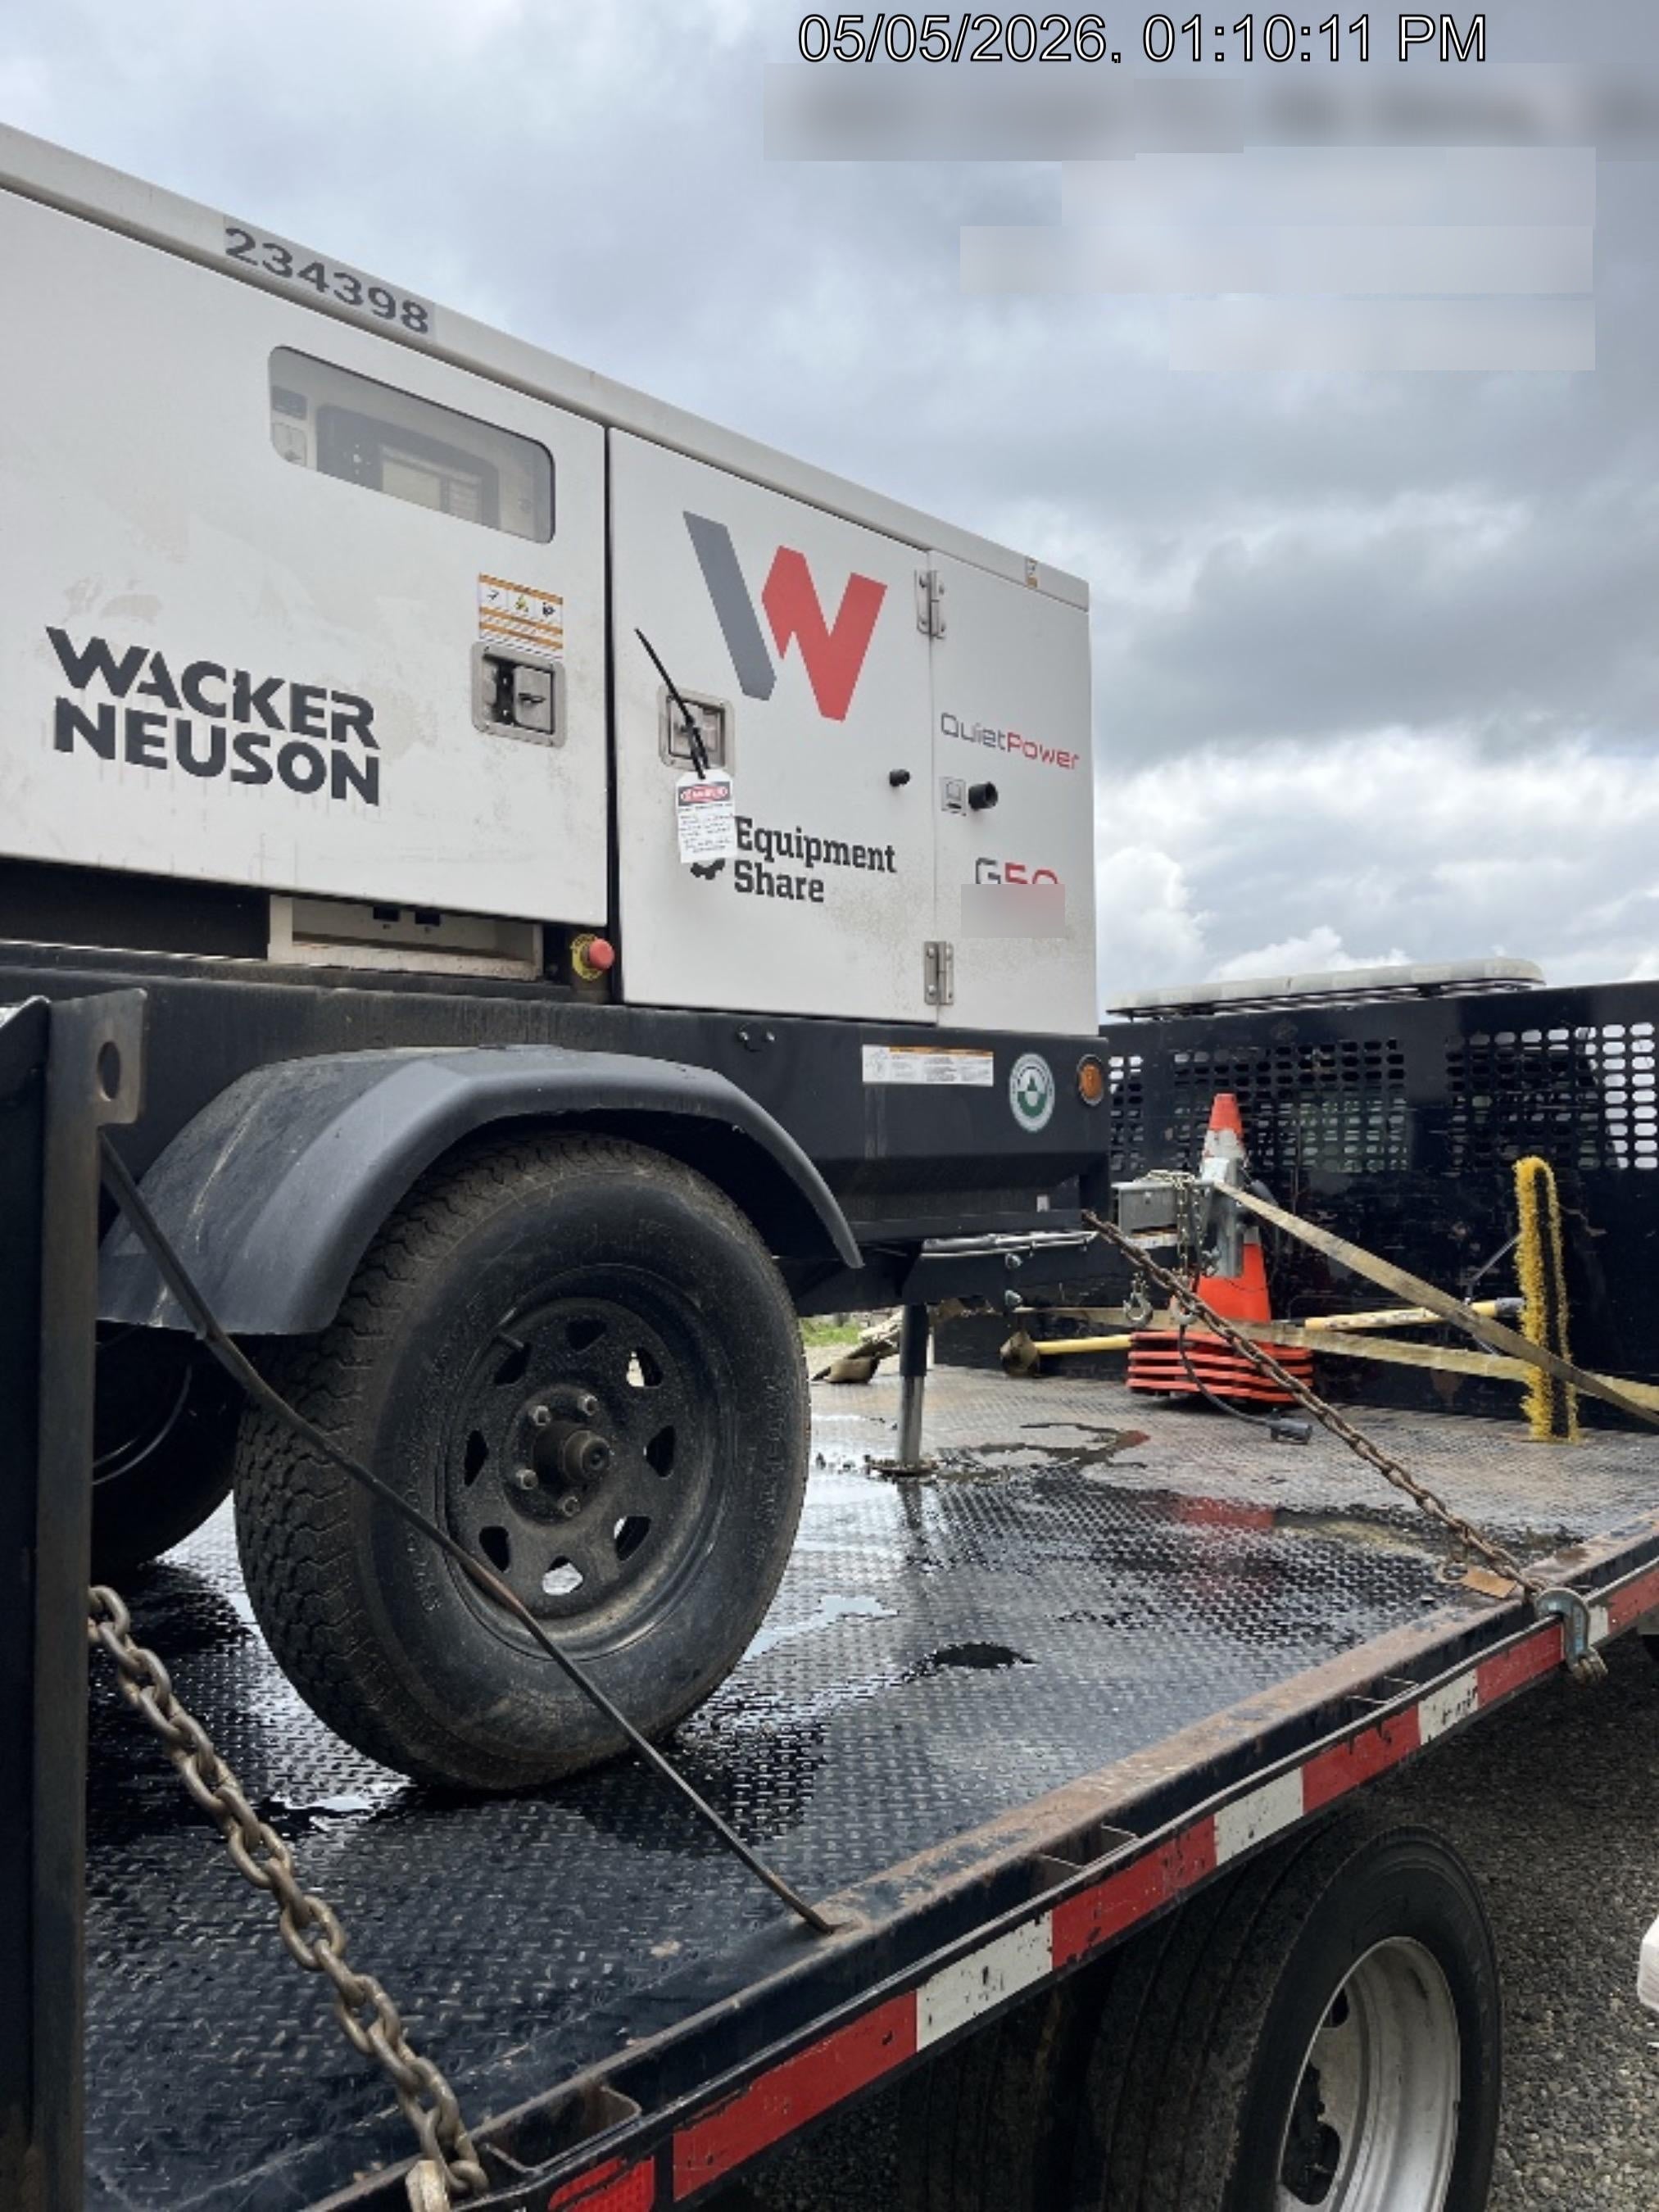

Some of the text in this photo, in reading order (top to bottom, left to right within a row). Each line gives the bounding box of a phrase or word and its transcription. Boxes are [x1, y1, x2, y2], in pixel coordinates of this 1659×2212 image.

[225, 228, 428, 333] 234398
[45, 626, 380, 749] WACKER
[53, 696, 379, 806] NEUSON
[941, 712, 1080, 769] QuietPower
[734, 815, 897, 873] Equipment
[734, 860, 824, 903] Share
